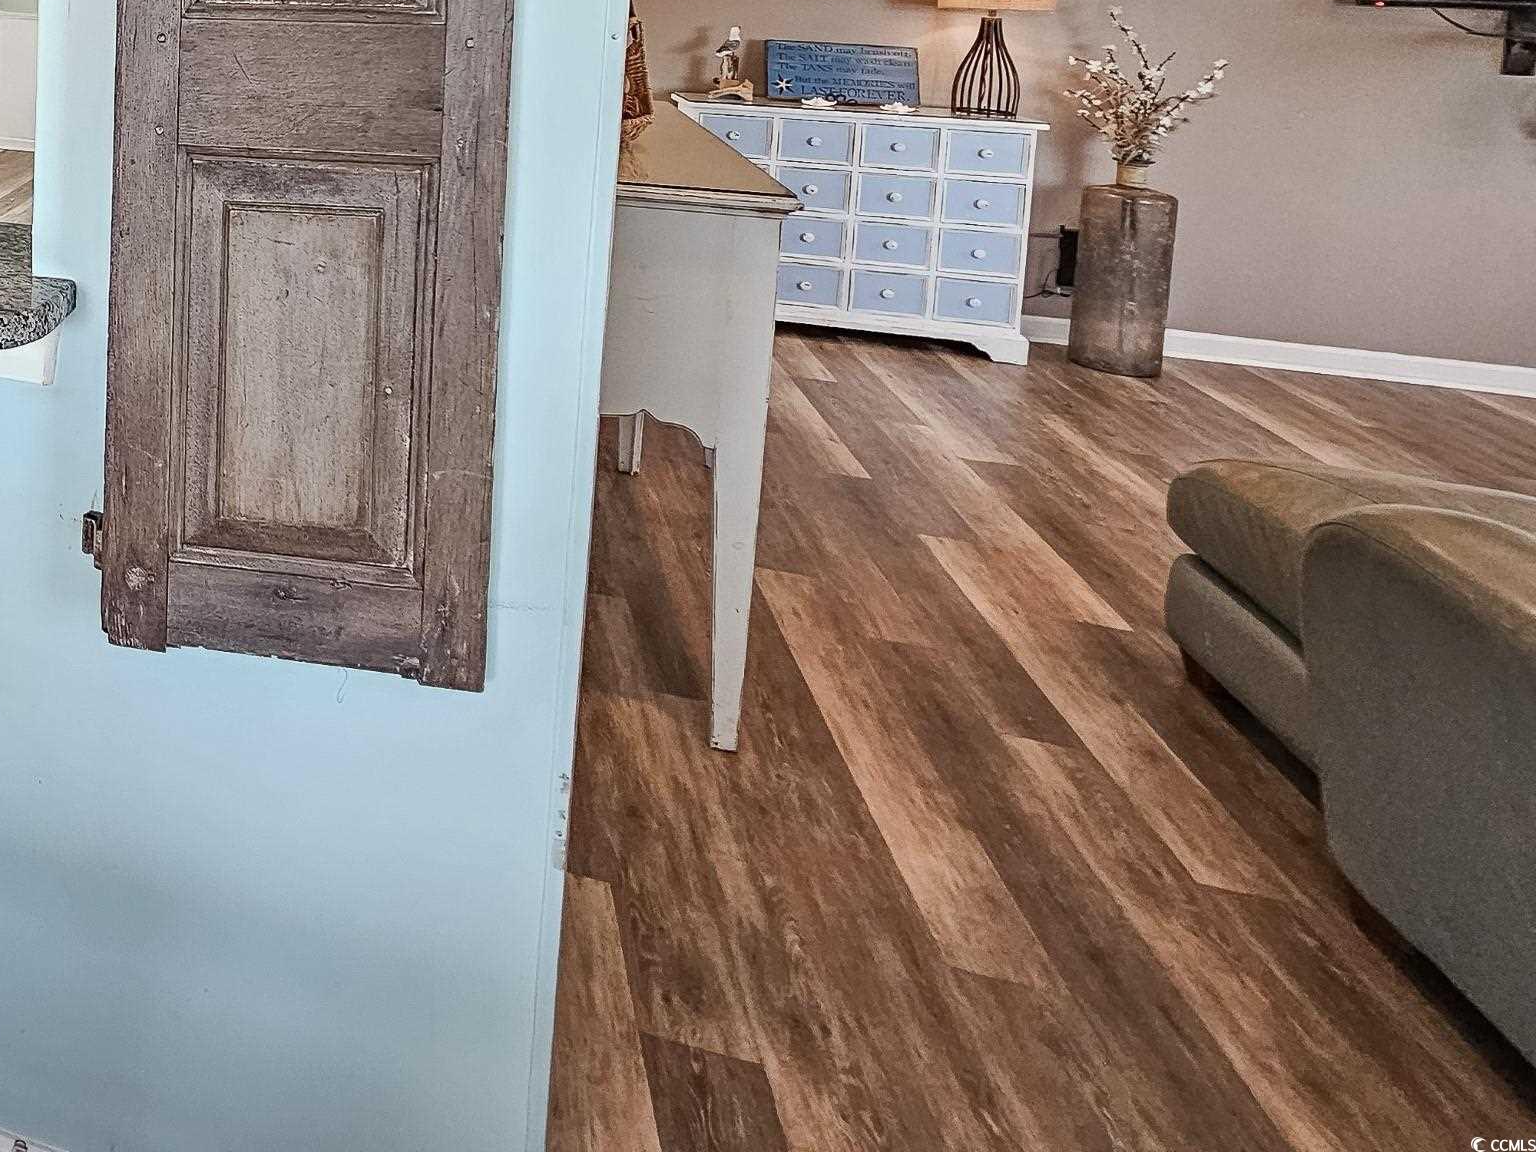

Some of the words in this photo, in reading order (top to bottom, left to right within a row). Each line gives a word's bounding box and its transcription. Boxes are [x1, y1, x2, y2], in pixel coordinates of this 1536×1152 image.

[798, 43, 833, 53] SAND
[834, 47, 857, 56] may
[798, 54, 828, 63] SALT
[777, 62, 798, 71] The
[801, 63, 833, 72] TANS
[832, 78, 896, 89] MEMORIES
[801, 86, 834, 96] LAST
